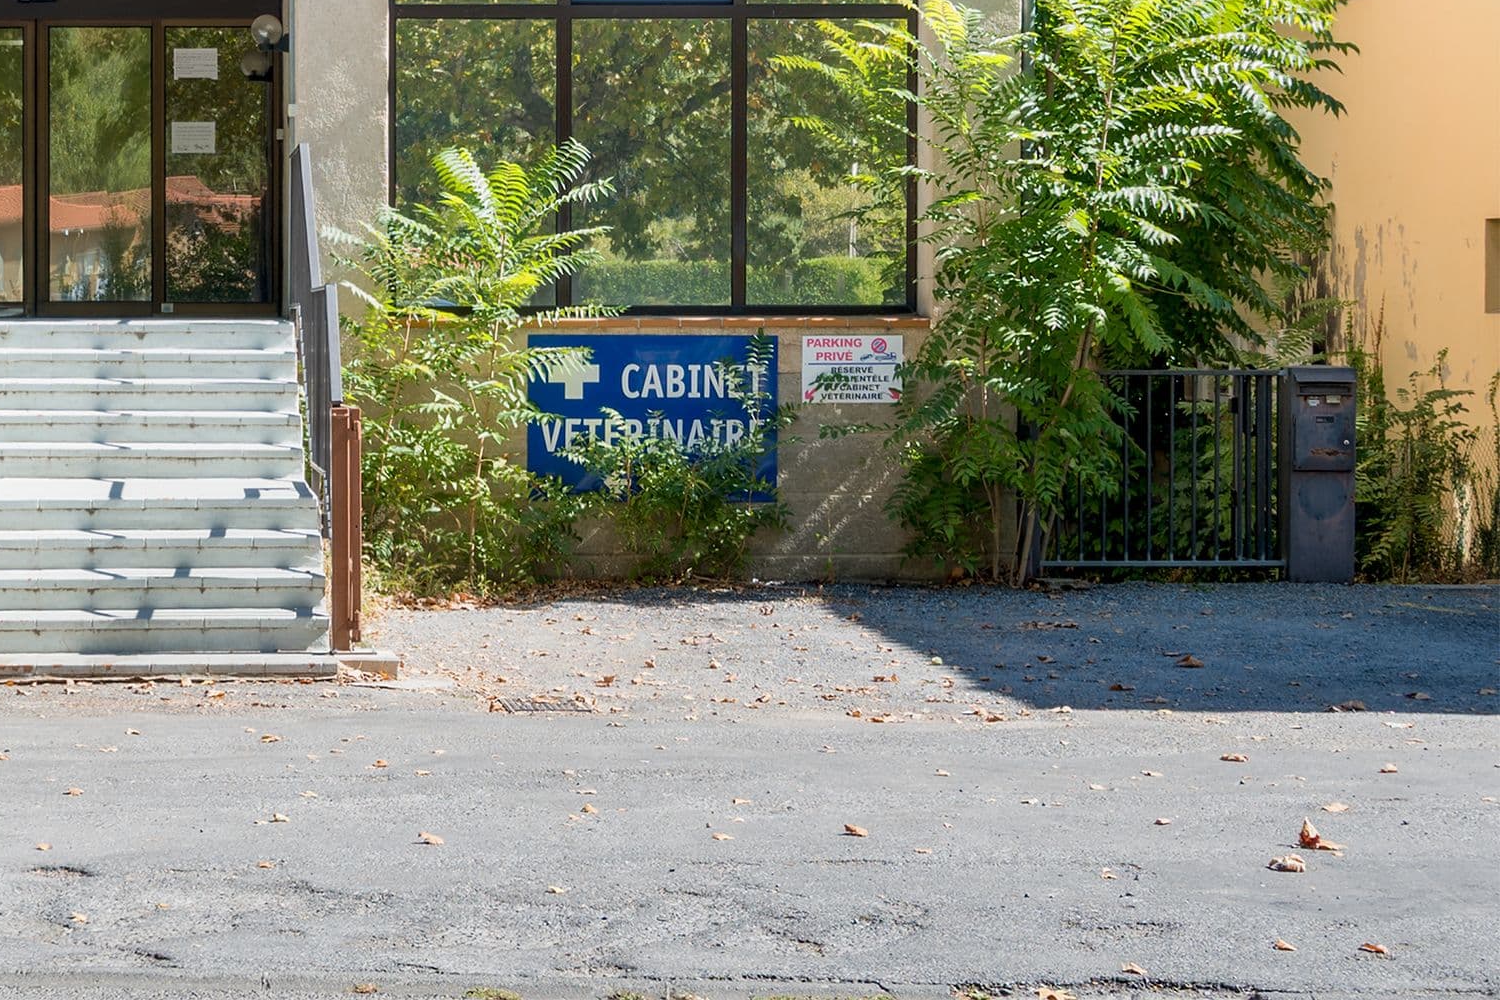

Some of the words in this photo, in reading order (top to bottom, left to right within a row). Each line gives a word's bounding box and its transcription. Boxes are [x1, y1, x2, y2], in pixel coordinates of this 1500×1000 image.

[806, 338, 863, 348] PARKING
[815, 350, 853, 361] PRIVÉ
[621, 363, 766, 399] CABINET
[840, 382, 881, 392] CABINET
[541, 417, 765, 453] VETERINAIRE
